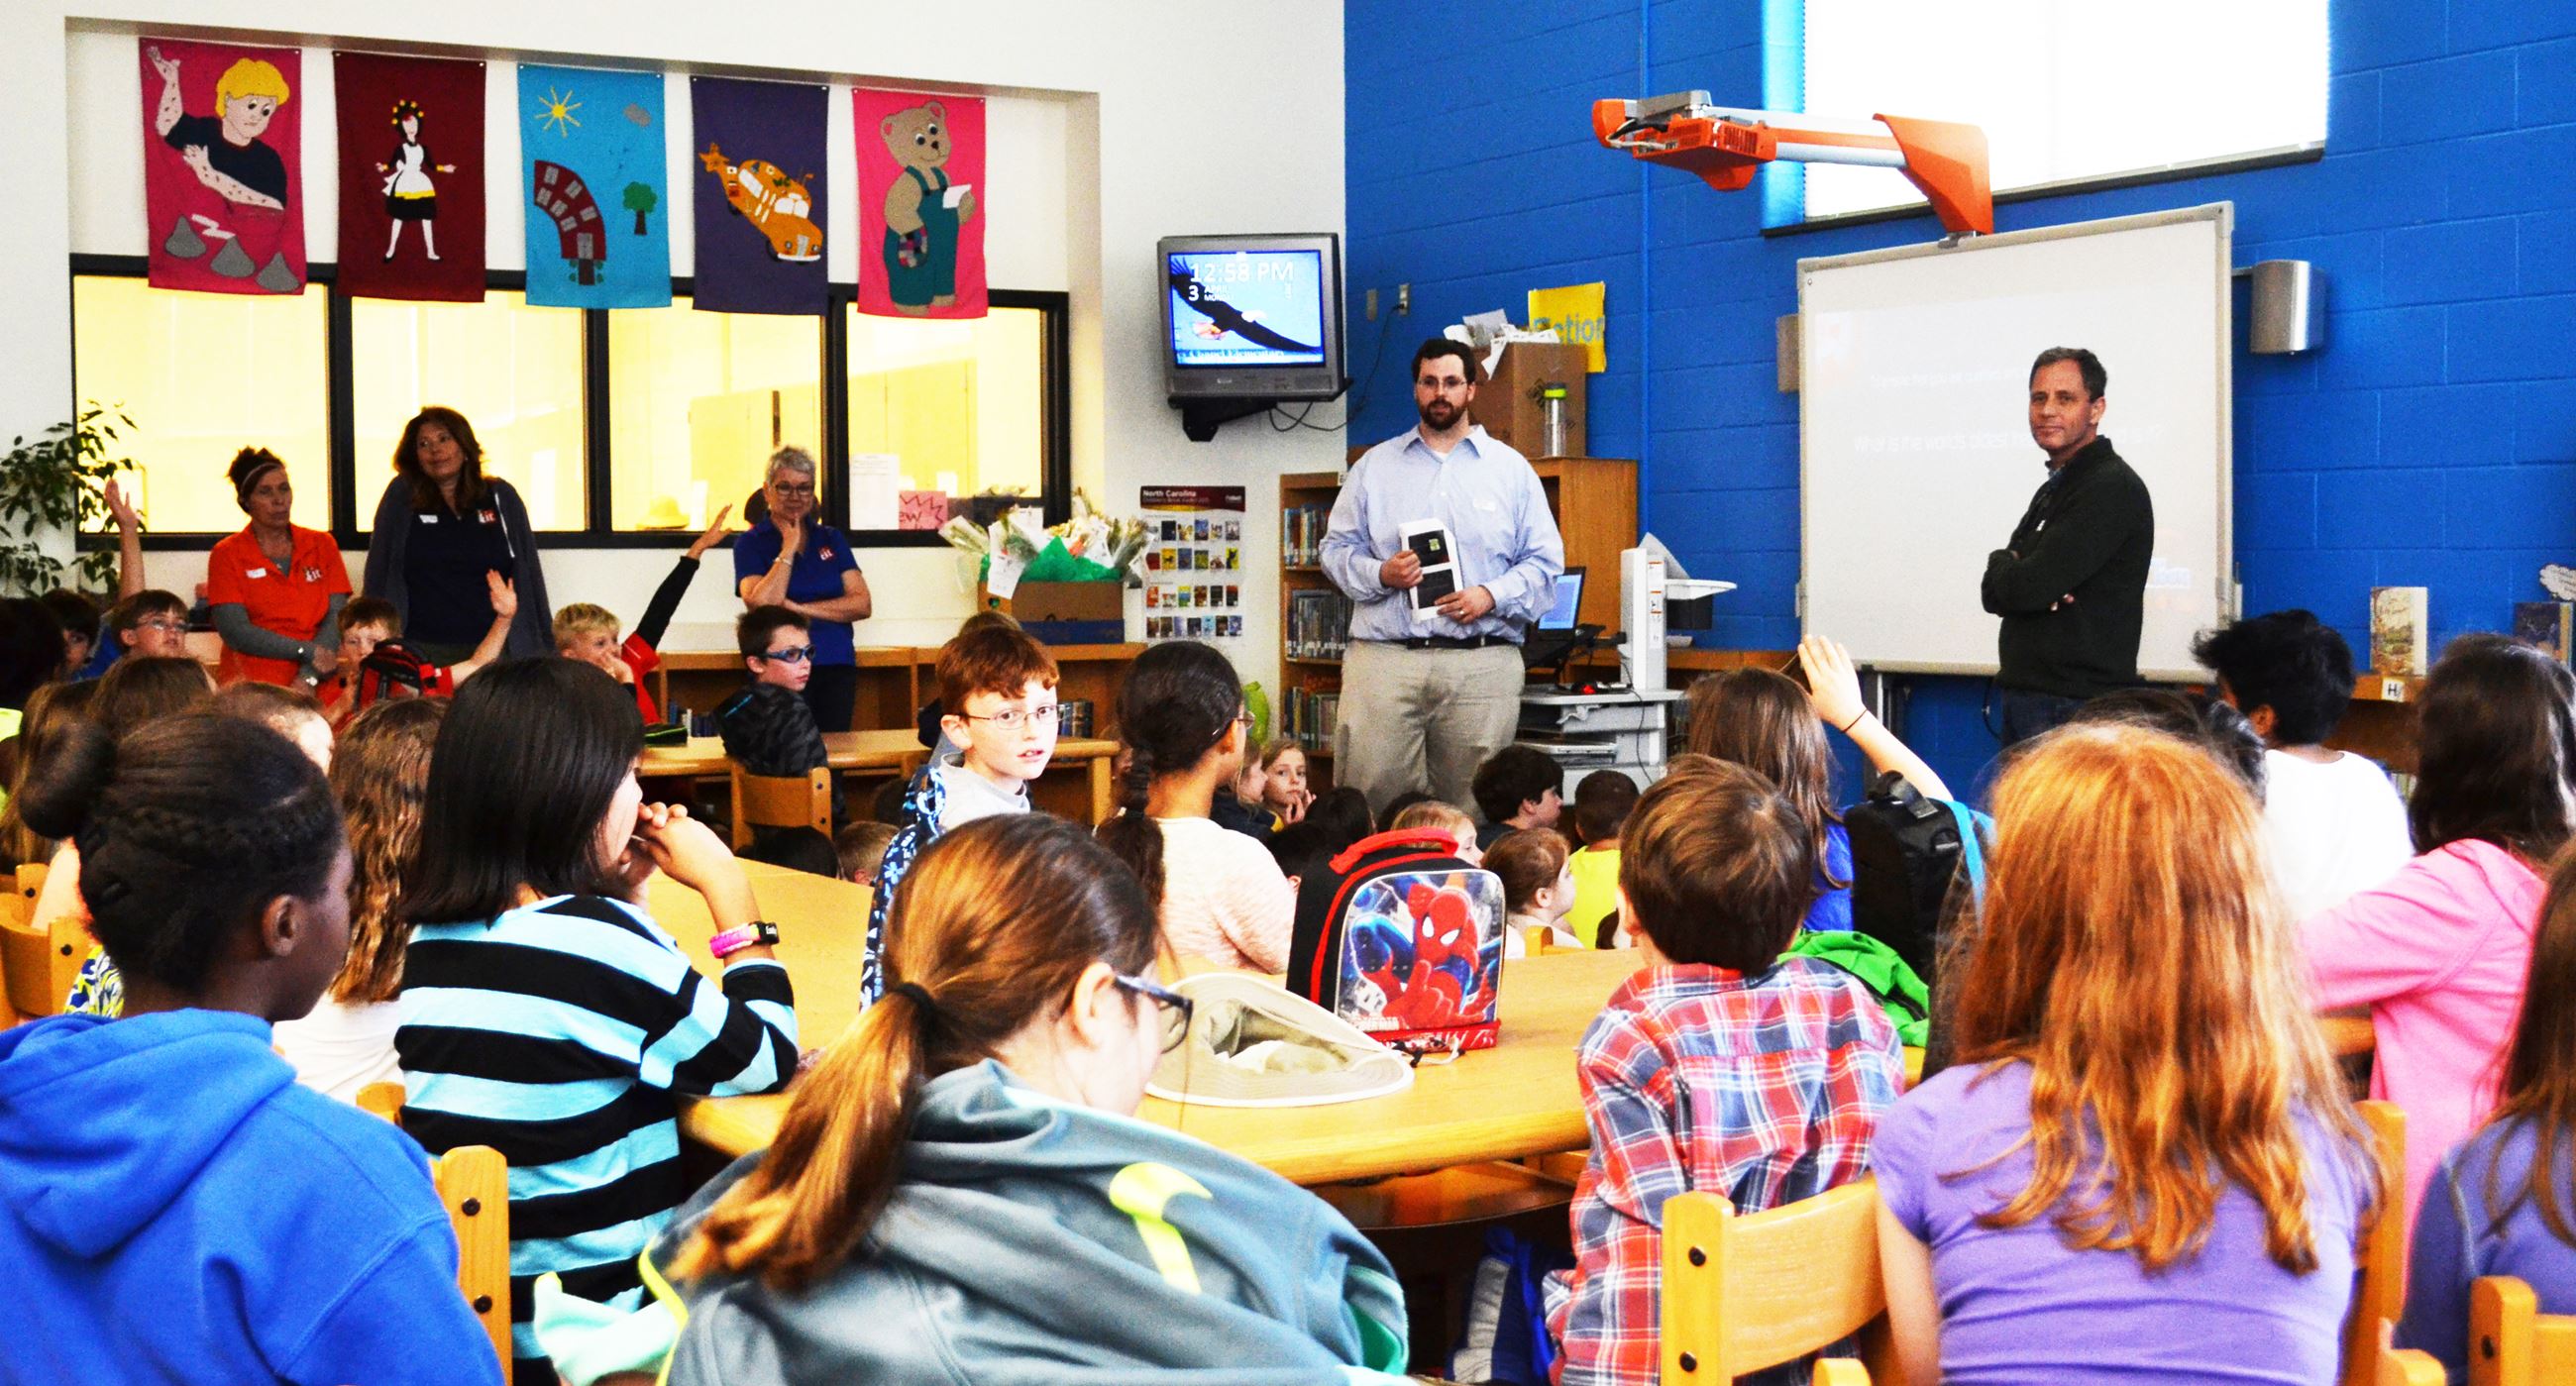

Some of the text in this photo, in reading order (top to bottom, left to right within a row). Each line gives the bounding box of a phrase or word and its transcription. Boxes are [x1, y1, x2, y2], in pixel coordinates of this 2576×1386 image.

[1190, 261, 1294, 282] 12:58 PM
[1188, 284, 1200, 302] 3
